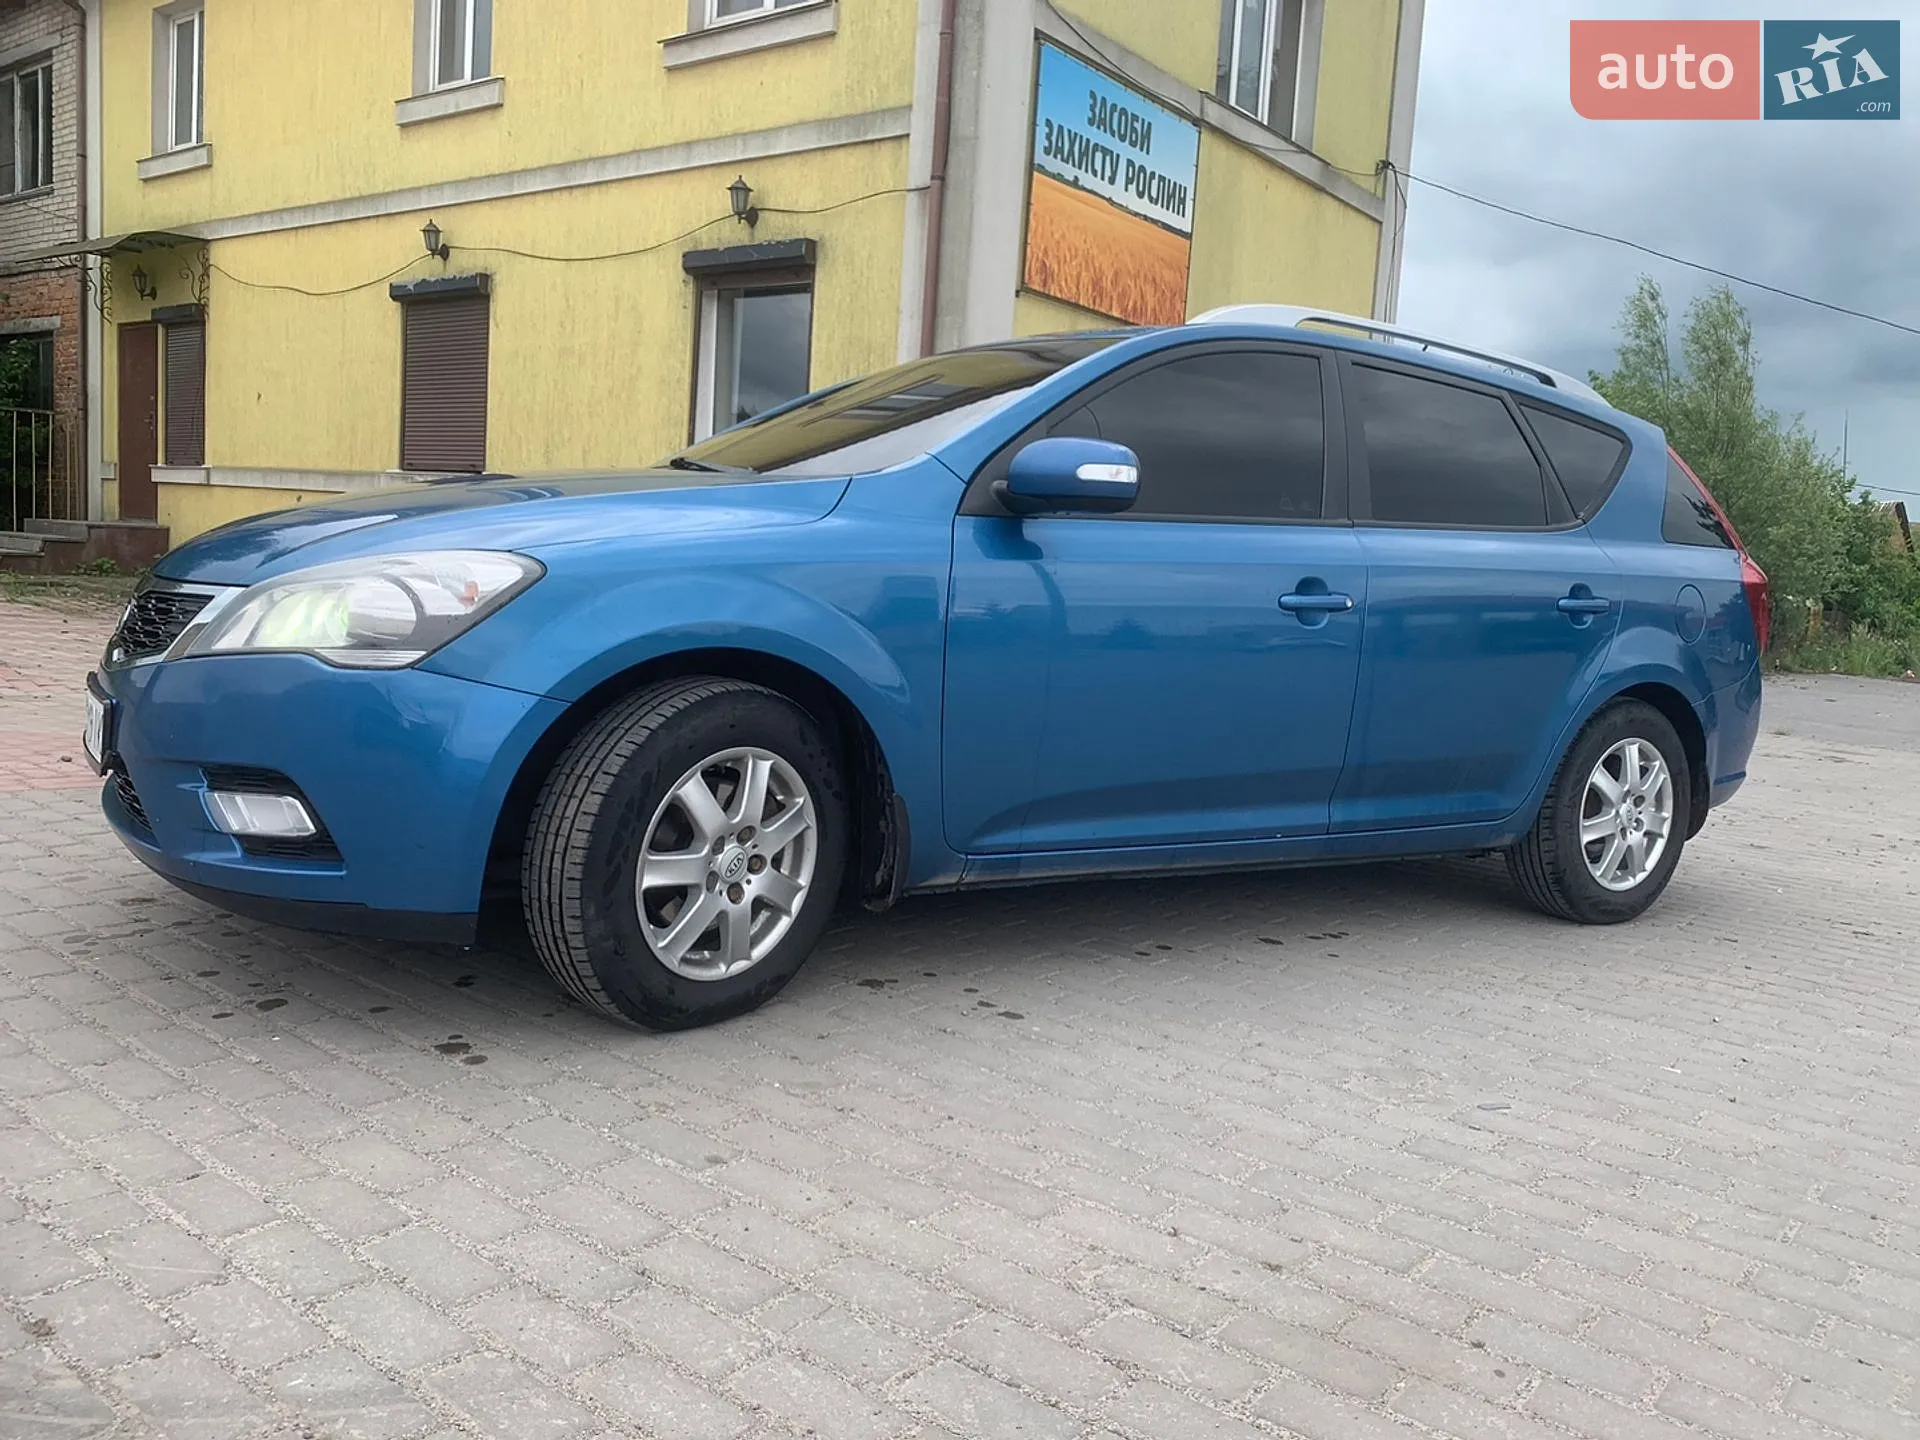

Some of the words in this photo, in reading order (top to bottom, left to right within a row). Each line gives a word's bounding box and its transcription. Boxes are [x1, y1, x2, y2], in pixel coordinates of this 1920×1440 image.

[1086, 89, 1153, 155] ЗАСОБИ
[1043, 118, 1120, 186] ЗАХИСТУ
[1124, 158, 1188, 218] РОСЛИН
[727, 856, 743, 875] KIA
